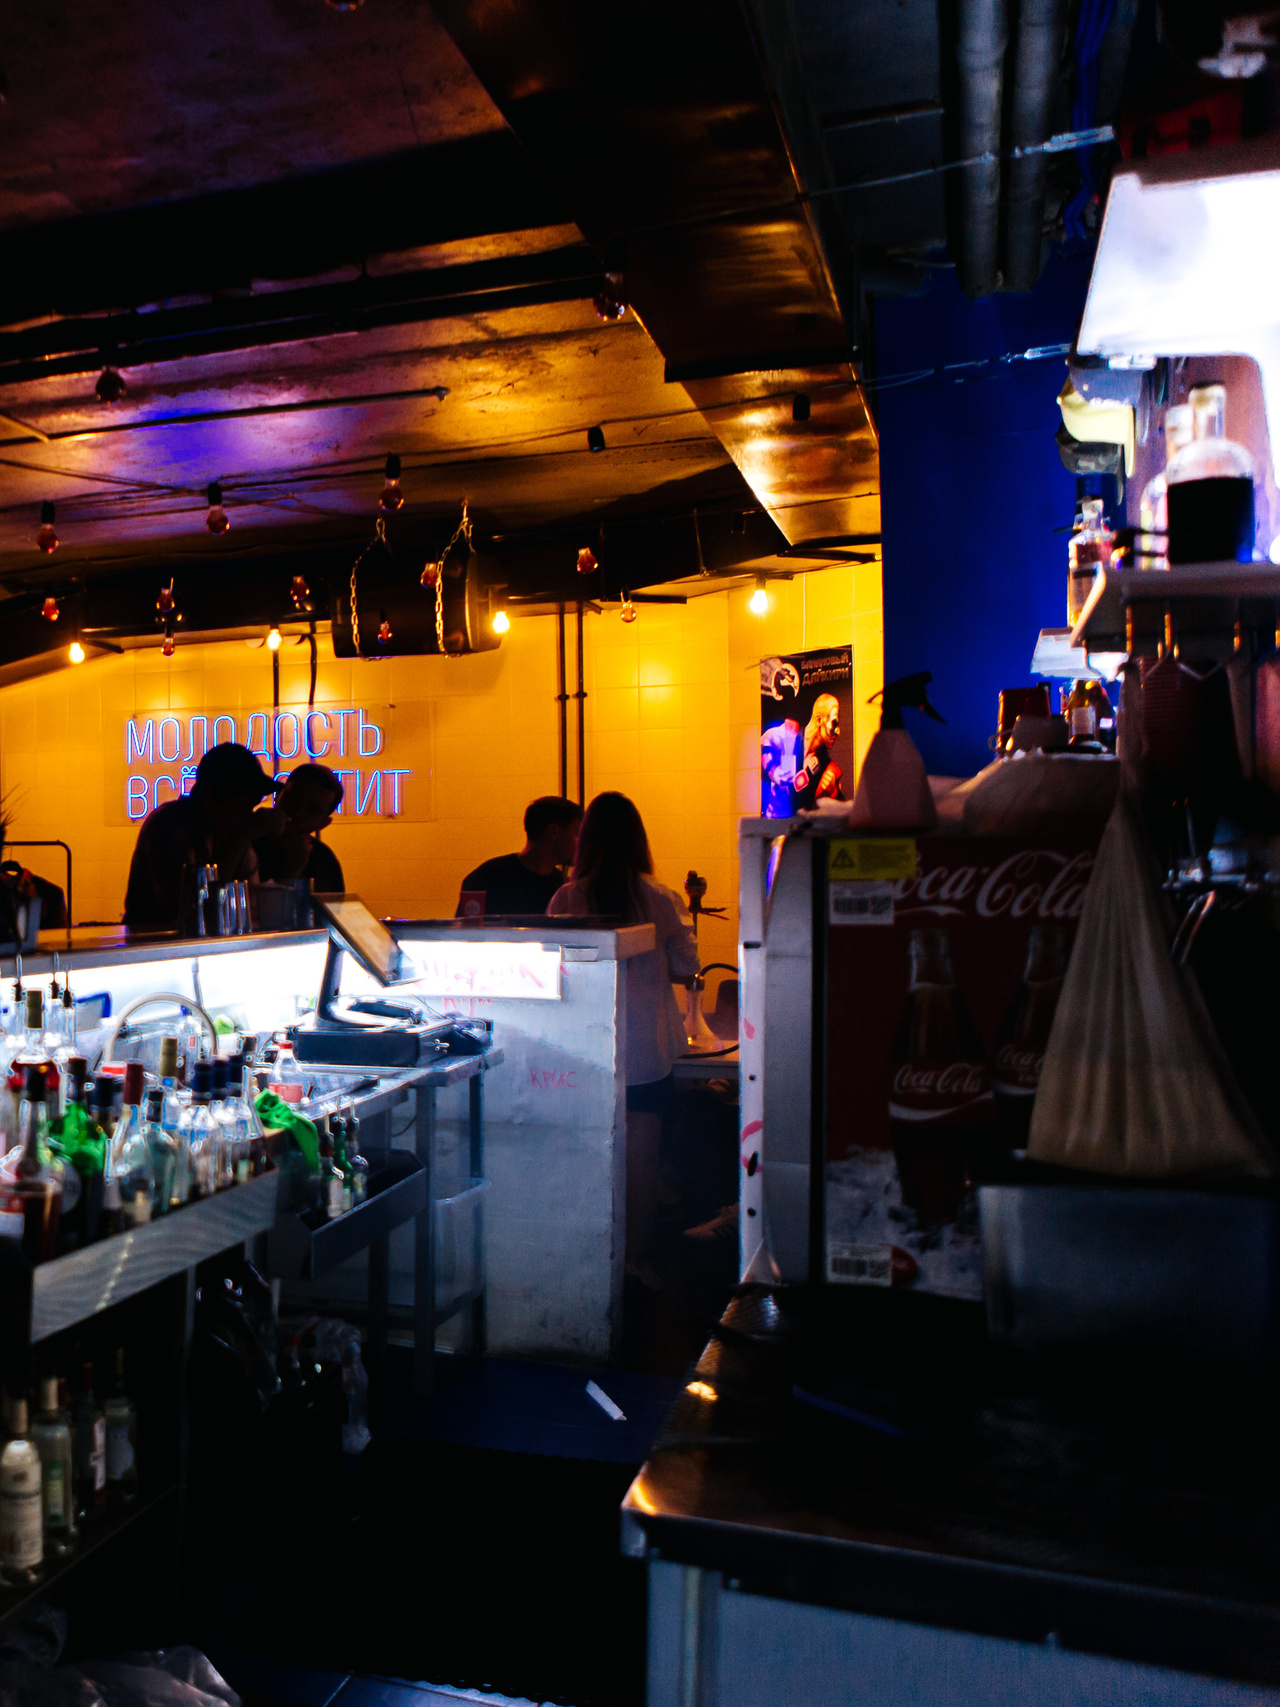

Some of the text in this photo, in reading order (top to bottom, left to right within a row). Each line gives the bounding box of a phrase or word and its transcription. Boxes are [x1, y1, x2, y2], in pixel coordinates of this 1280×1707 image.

[802, 667, 850, 686] ДАЙКИРИ
[126, 707, 381, 764] МОЛОДОСТЬ
[894, 849, 1094, 918] oca-Cola
[894, 1062, 985, 1094] Coca-Cola
